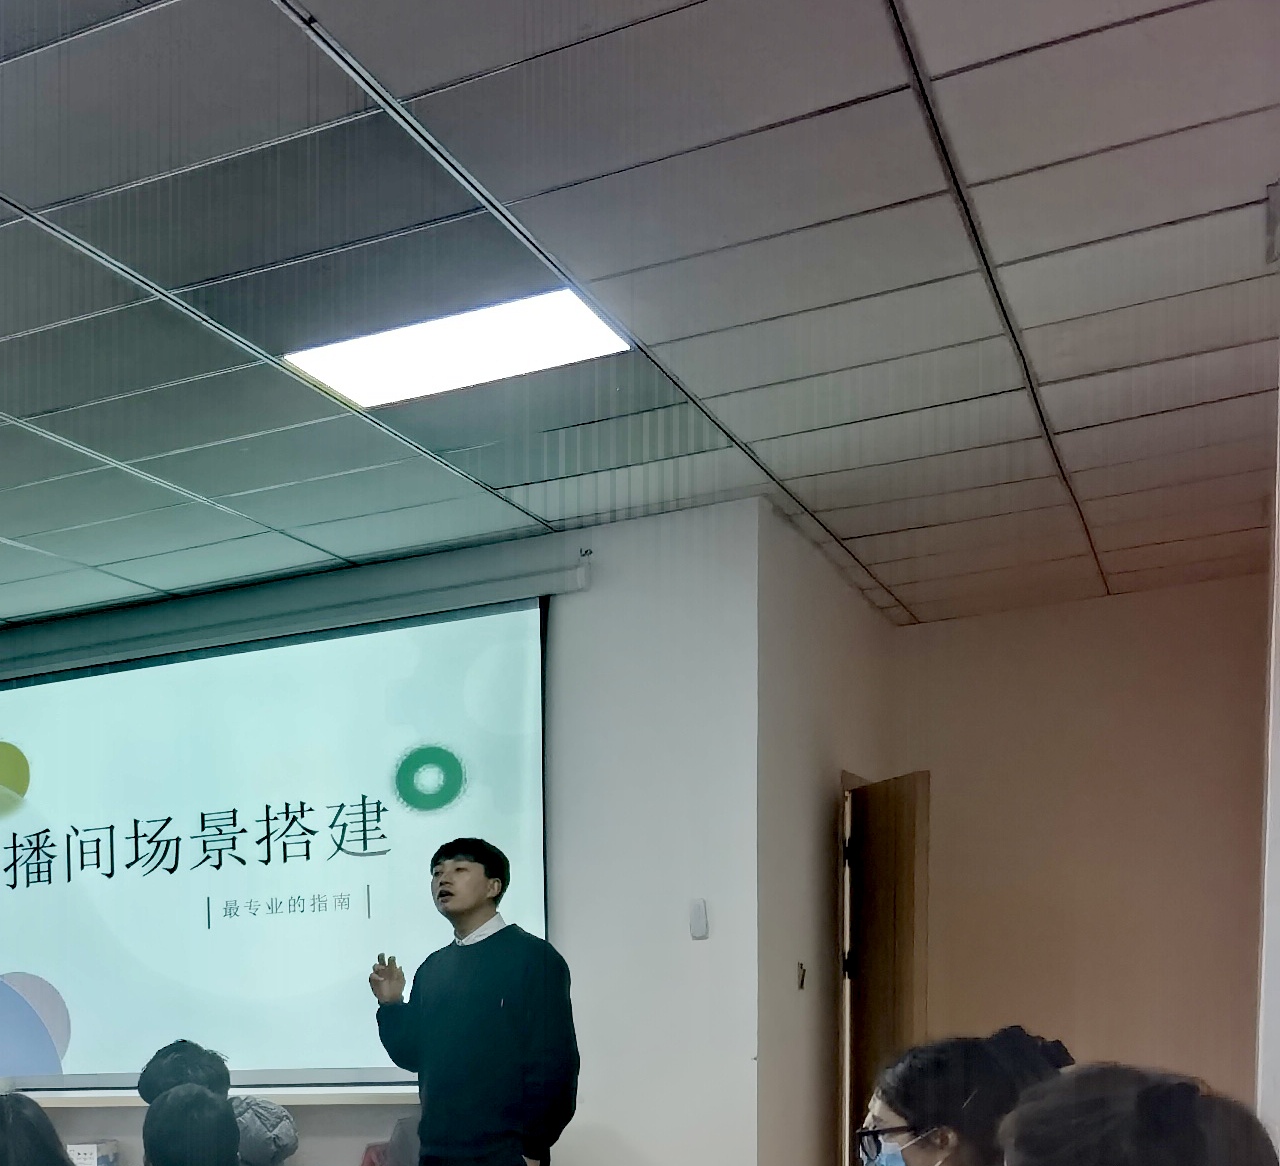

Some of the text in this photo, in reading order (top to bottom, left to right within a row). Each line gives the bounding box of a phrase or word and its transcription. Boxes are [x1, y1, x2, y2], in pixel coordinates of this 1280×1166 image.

[222, 892, 352, 919] 最专业的指南
